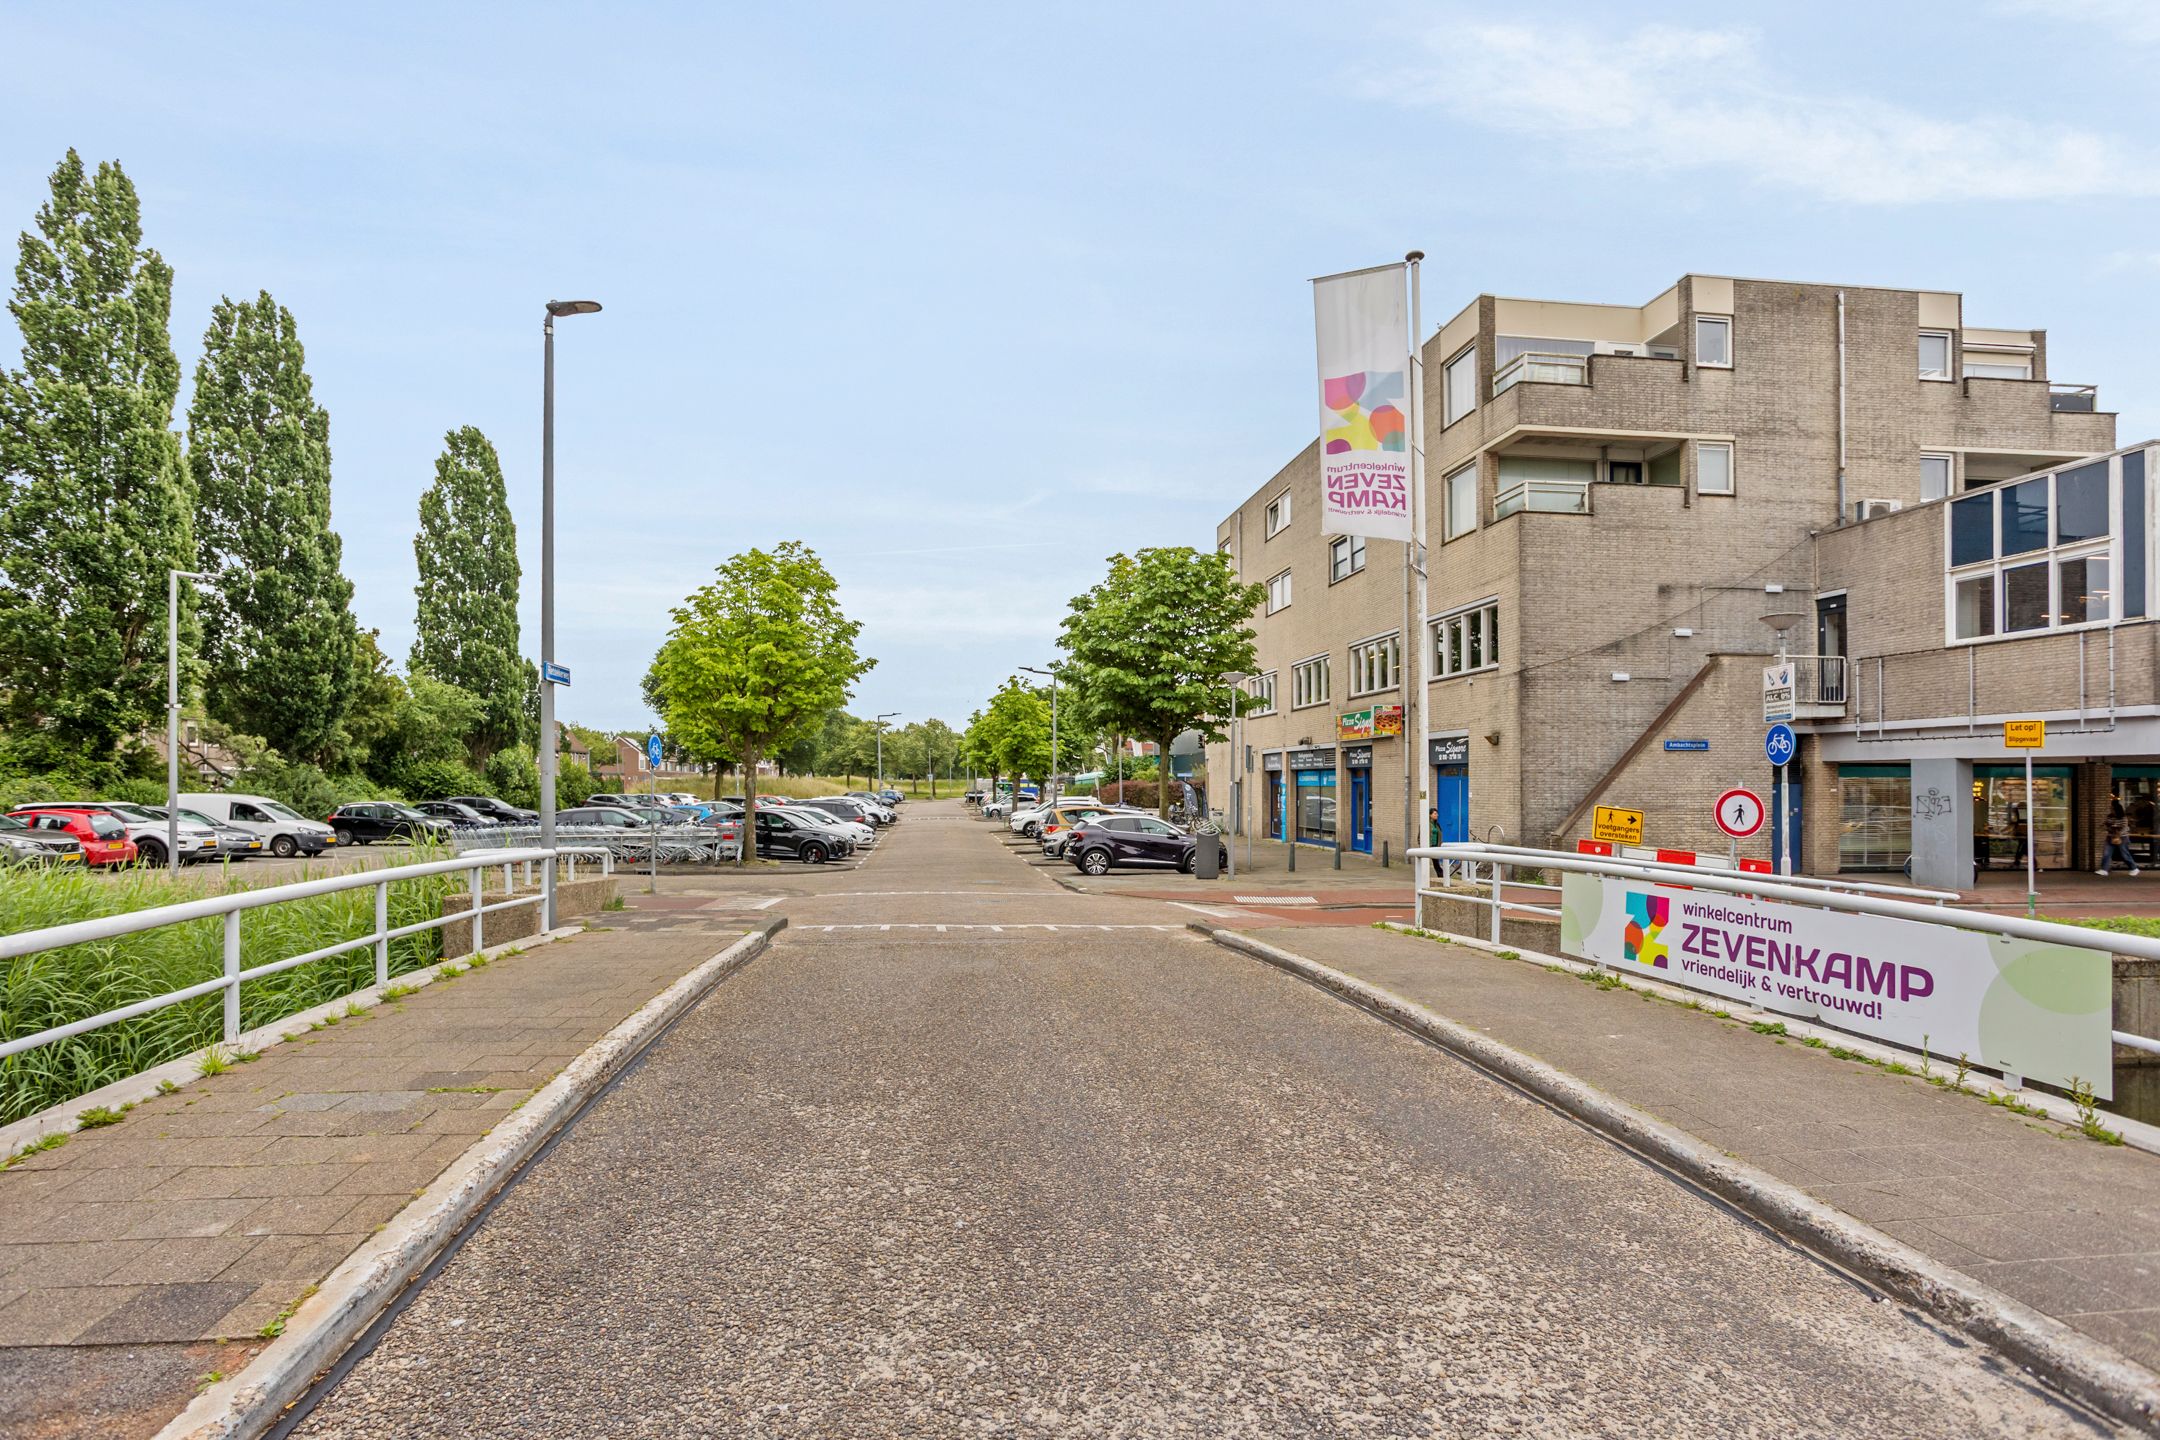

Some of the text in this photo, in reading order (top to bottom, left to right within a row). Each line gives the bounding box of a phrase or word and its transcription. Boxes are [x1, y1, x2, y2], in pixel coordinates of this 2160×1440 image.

[2024, 723, 2036, 732] op!
[1597, 823, 1640, 834] voetgangers
[1599, 831, 1637, 840] oversteken
[1683, 903, 1793, 934] winkelcentrum
[1681, 922, 1934, 1002] ZEVENKAMP
[1681, 958, 1882, 1020] vriendelijk & vertrouwd!
